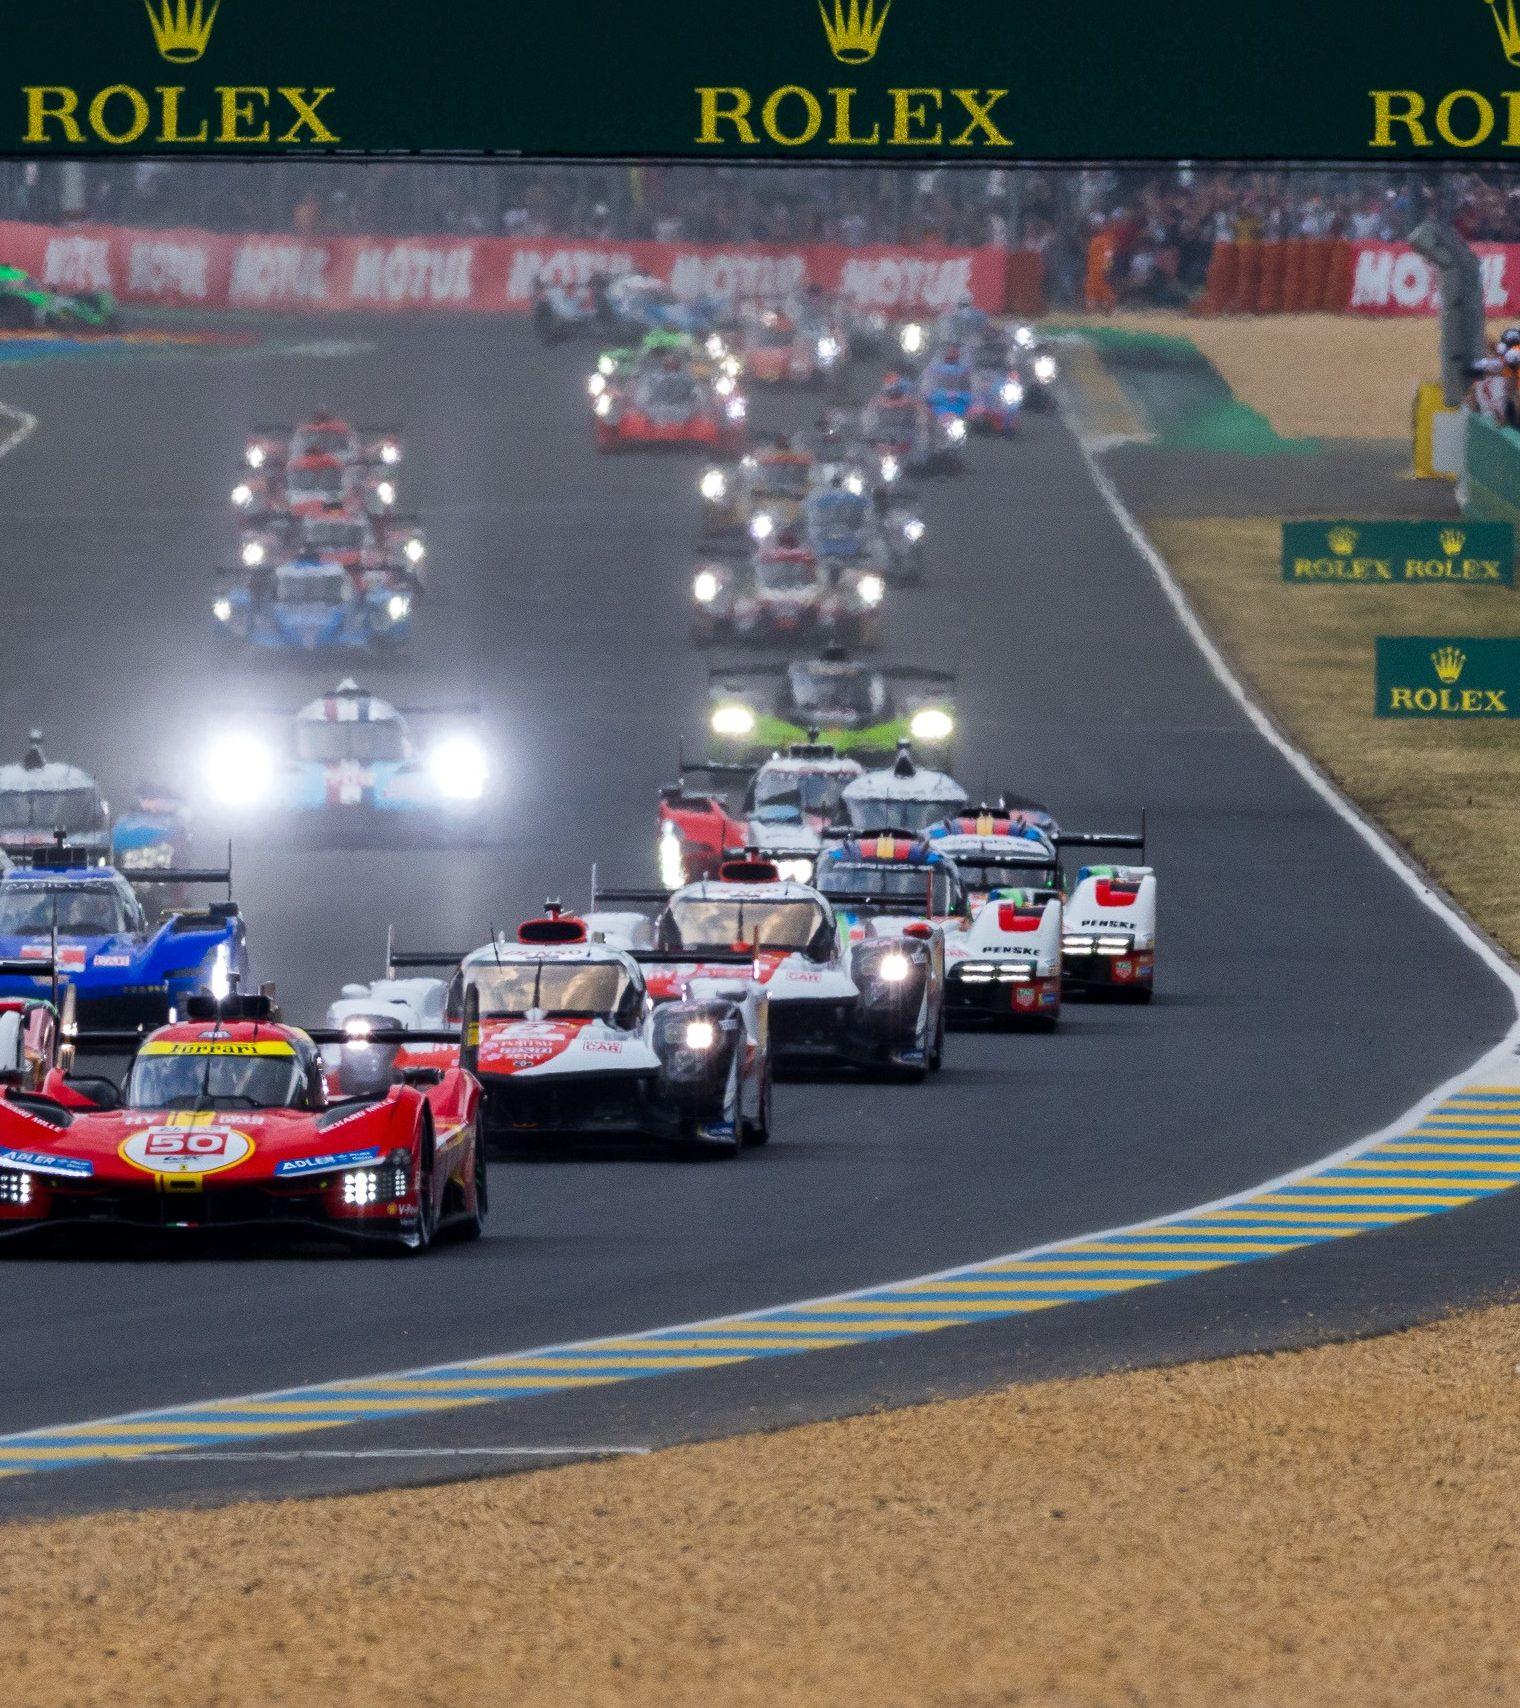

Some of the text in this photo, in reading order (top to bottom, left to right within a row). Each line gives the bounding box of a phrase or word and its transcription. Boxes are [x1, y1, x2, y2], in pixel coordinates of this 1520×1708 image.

[22, 84, 341, 144] ROLEX
[695, 85, 1014, 147] ROLEX
[352, 247, 472, 299] MOTUL
[1351, 250, 1509, 308] MOL
[1294, 557, 1500, 579] ROLEX ROLEX
[1390, 687, 1509, 711] ROLEX
[1081, 920, 1137, 930] PENSKE
[983, 946, 1040, 956] PENSKE
[149, 1134, 223, 1153] 50
[3, 1151, 56, 1165] ADLER
[282, 1156, 336, 1170] ADLER
